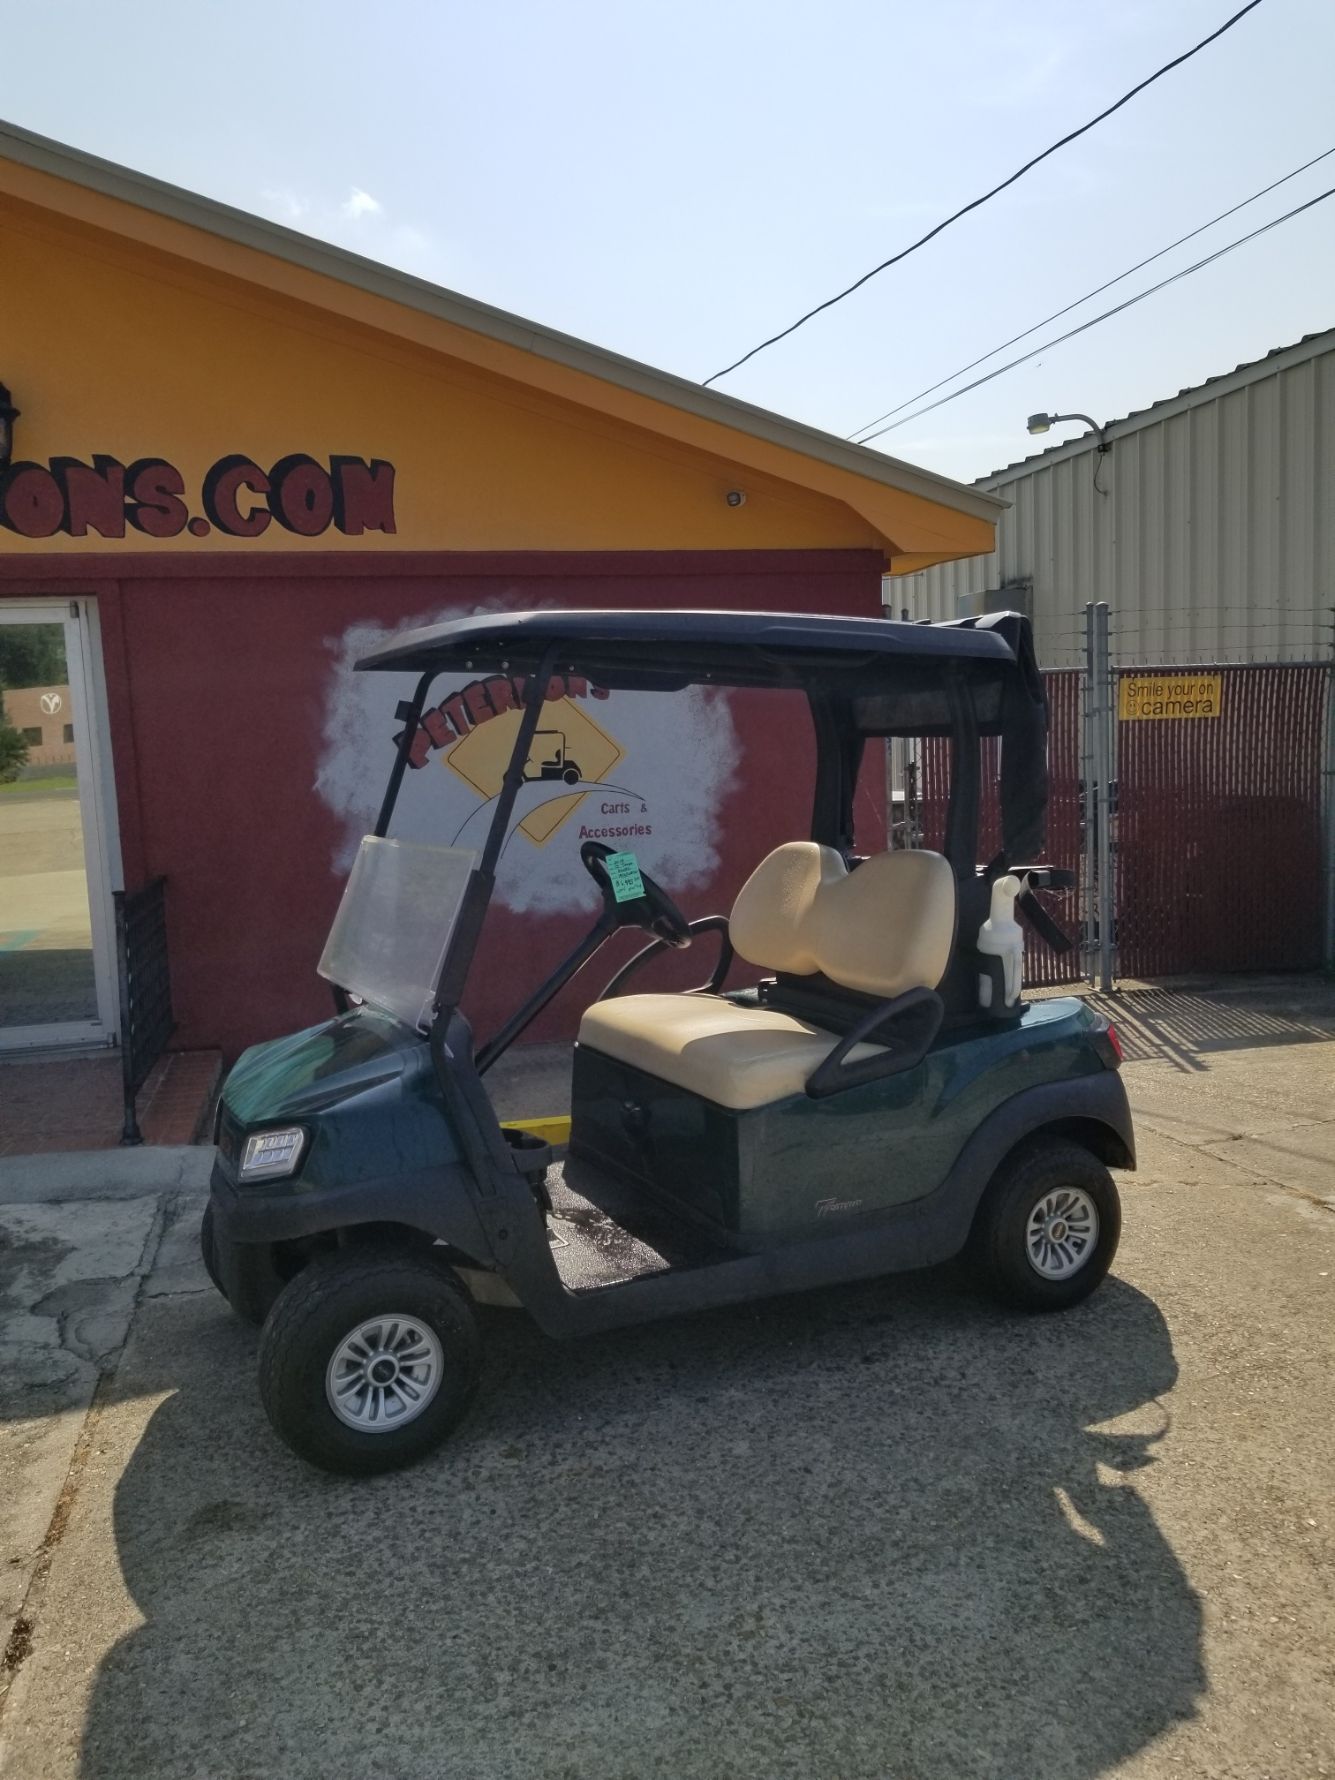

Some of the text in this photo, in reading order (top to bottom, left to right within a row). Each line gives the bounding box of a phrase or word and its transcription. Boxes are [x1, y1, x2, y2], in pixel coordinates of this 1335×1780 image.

[0, 453, 397, 538] ONS.COM
[1127, 682, 1214, 699] Smile your on
[1141, 698, 1213, 715] camera
[600, 802, 648, 814] Carts &
[578, 824, 652, 840] Accessories
